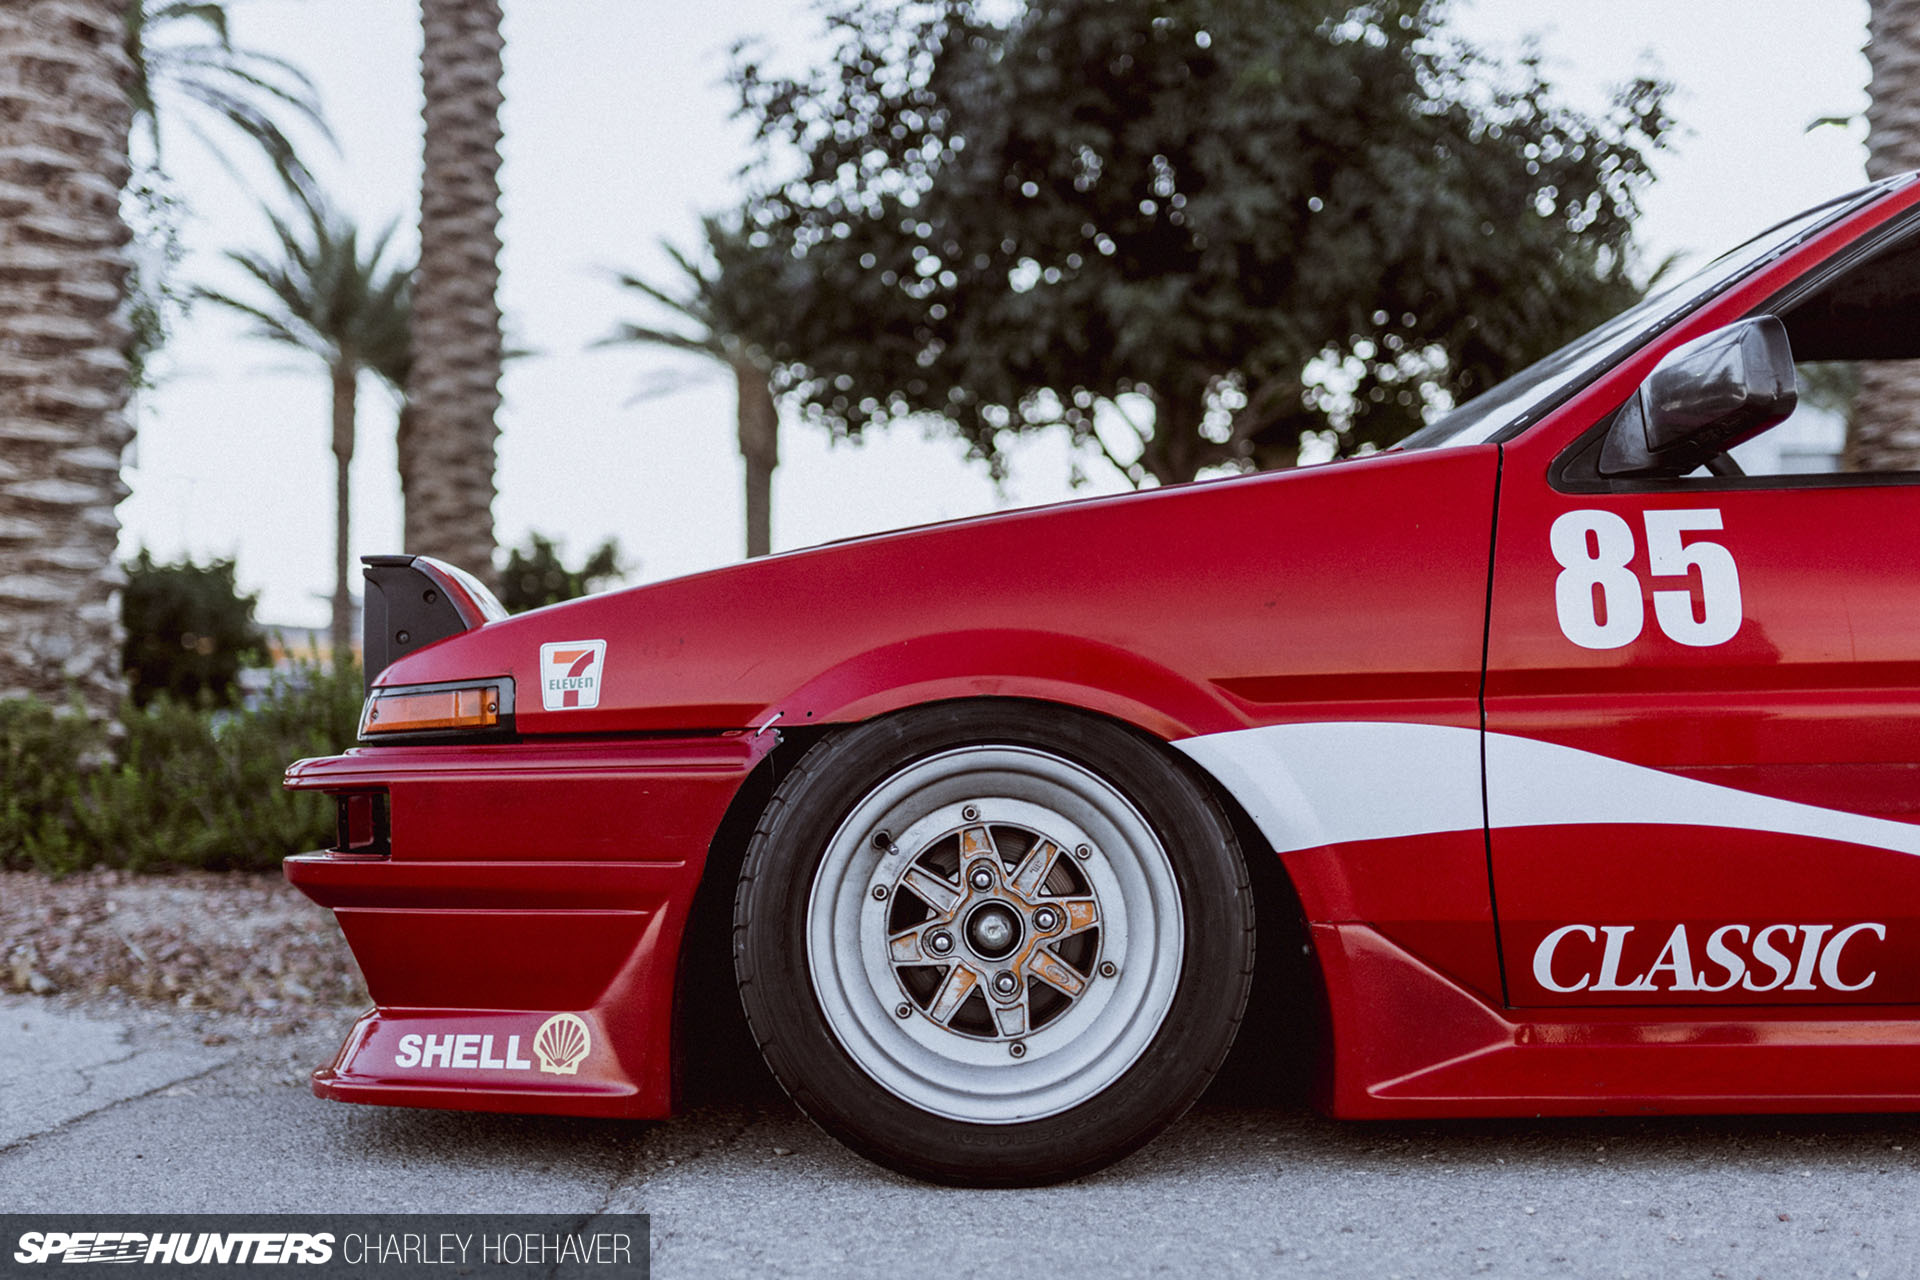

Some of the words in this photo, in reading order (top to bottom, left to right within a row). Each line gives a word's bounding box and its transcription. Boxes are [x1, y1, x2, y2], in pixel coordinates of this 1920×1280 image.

[1550, 509, 1743, 650] 85
[1533, 923, 1886, 992] CLASSIC
[395, 1034, 531, 1069] SHELL
